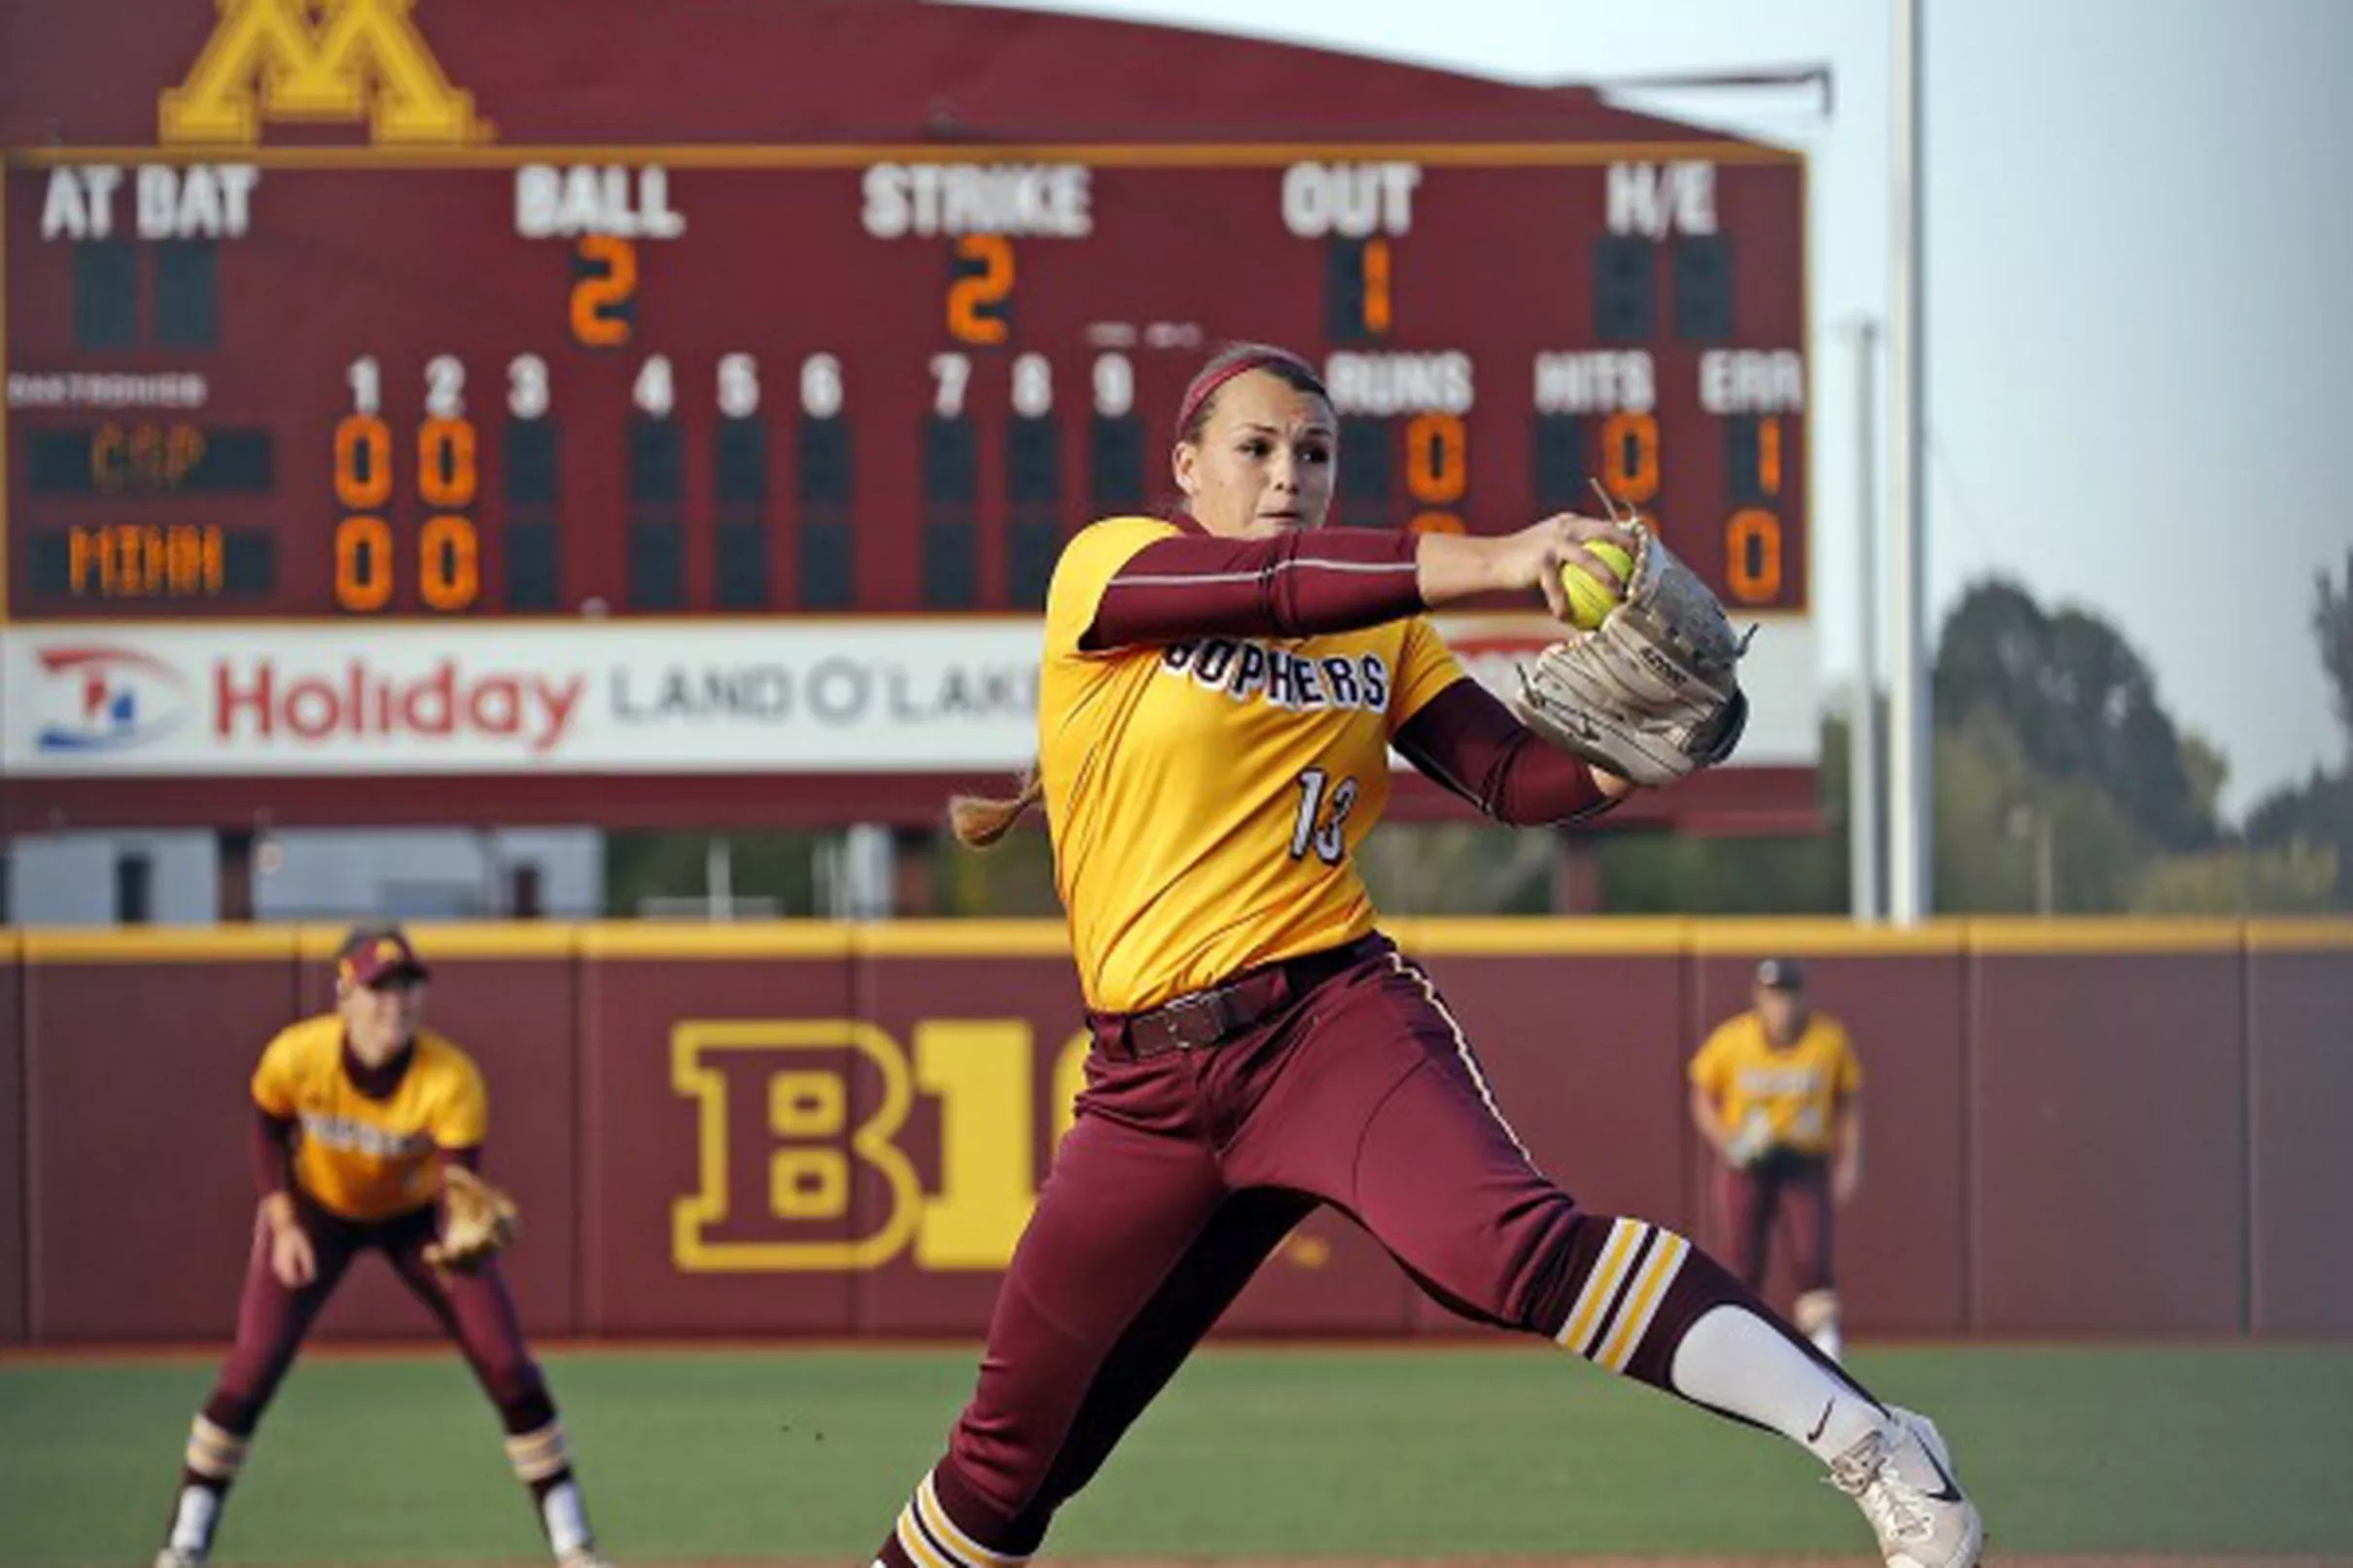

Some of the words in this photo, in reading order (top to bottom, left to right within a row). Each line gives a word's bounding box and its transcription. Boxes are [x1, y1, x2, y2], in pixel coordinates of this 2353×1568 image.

[42, 165, 119, 239] AT
[136, 165, 258, 239] BAT
[514, 165, 684, 238] BALL
[862, 164, 1091, 238] STRIKE
[1282, 161, 1419, 238] OUT
[1606, 162, 1717, 239] H/E
[570, 234, 637, 345] 2
[946, 234, 1014, 344] 2
[1363, 238, 1390, 332] 1
[349, 357, 380, 415] 1
[426, 355, 465, 418] 2
[508, 355, 549, 418] 3
[634, 355, 674, 418] 4
[931, 353, 969, 418] 7
[1326, 352, 1473, 415] RUNS
[1534, 351, 1655, 413] HITS
[335, 415, 391, 506] 0
[419, 417, 475, 506] 0
[1408, 413, 1465, 503] 0
[1605, 412, 1659, 503] 0
[1759, 417, 1781, 494] 1
[335, 516, 392, 610] 0
[420, 517, 477, 610] 0
[1727, 509, 1781, 603] 0
[213, 657, 585, 752] Holiday
[611, 663, 787, 725] LAND
[1289, 766, 1359, 867] 13
